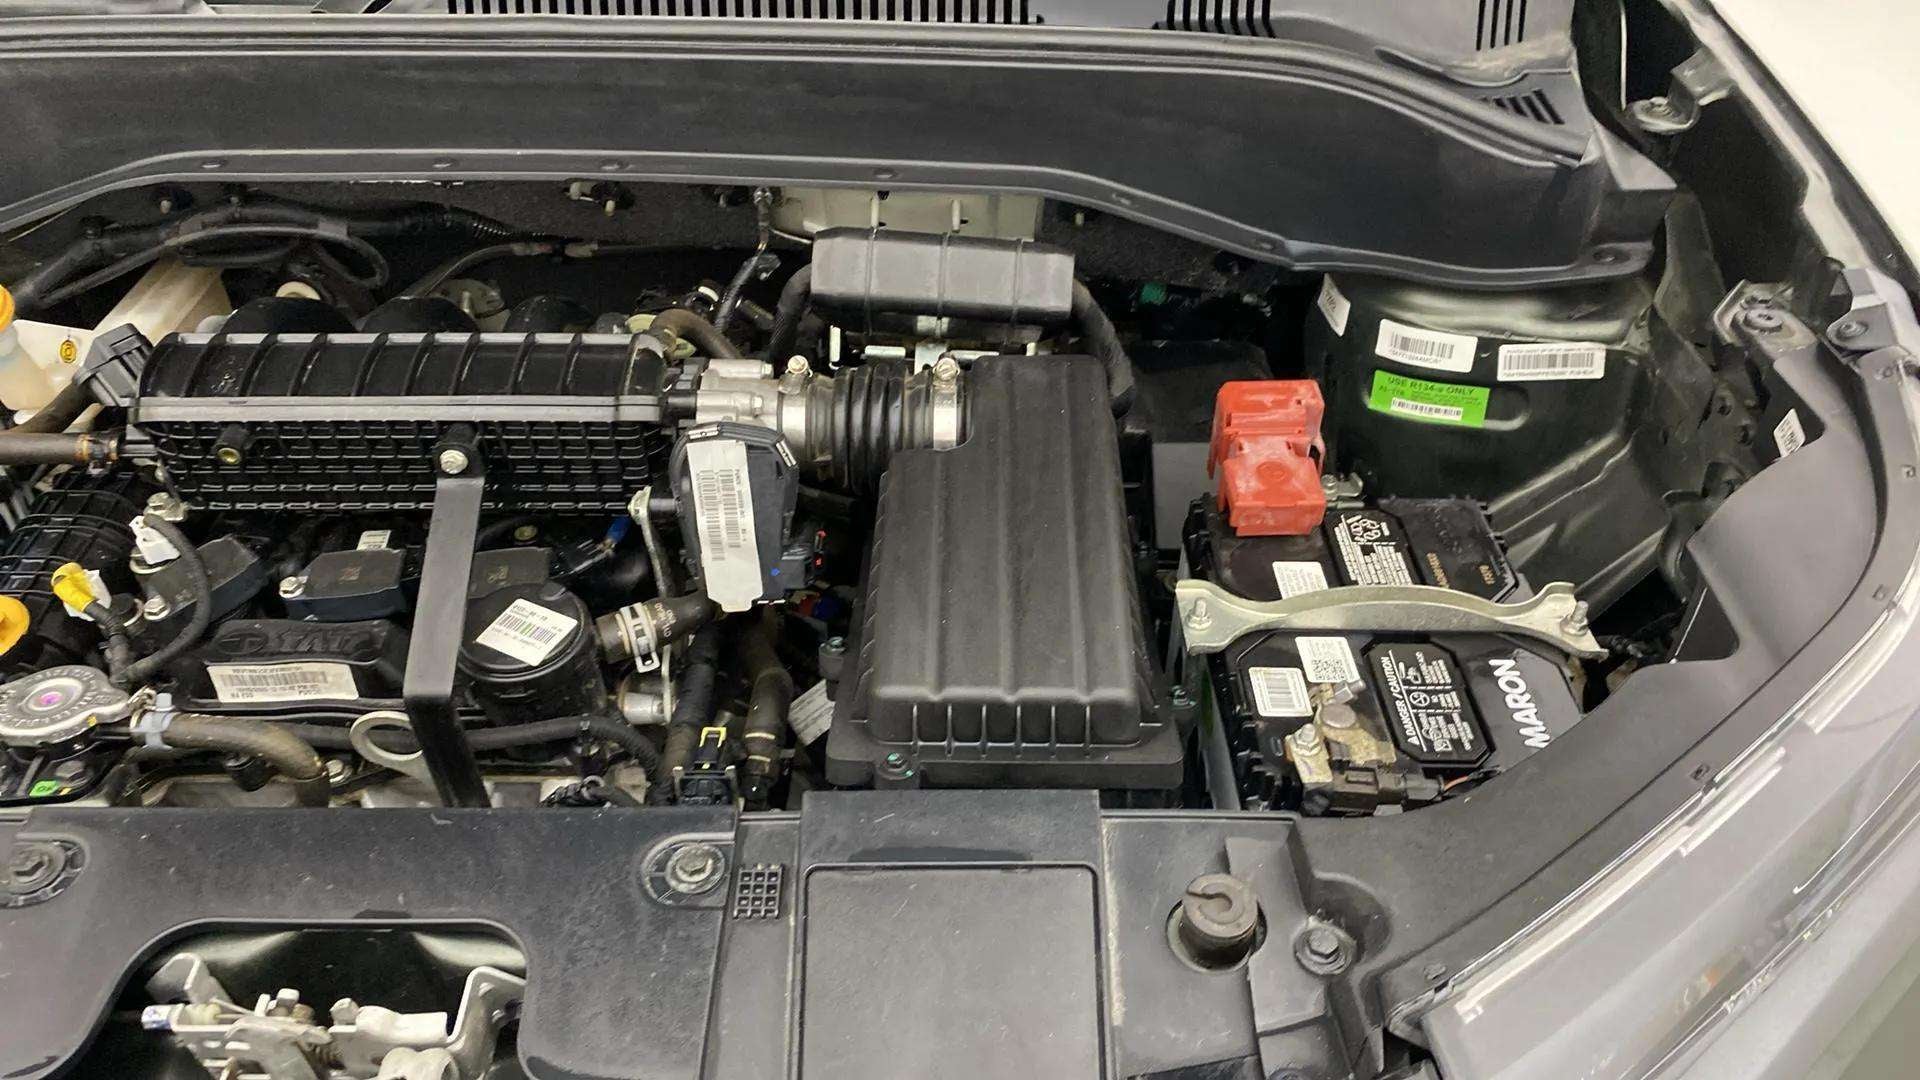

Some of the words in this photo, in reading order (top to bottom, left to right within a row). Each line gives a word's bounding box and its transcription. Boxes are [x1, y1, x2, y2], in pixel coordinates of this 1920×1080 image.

[1388, 377, 1405, 386] USE
[1447, 384, 1474, 394] ONLY
[1380, 656, 1401, 692] CAUTION
[1395, 699, 1416, 736] DANGER
